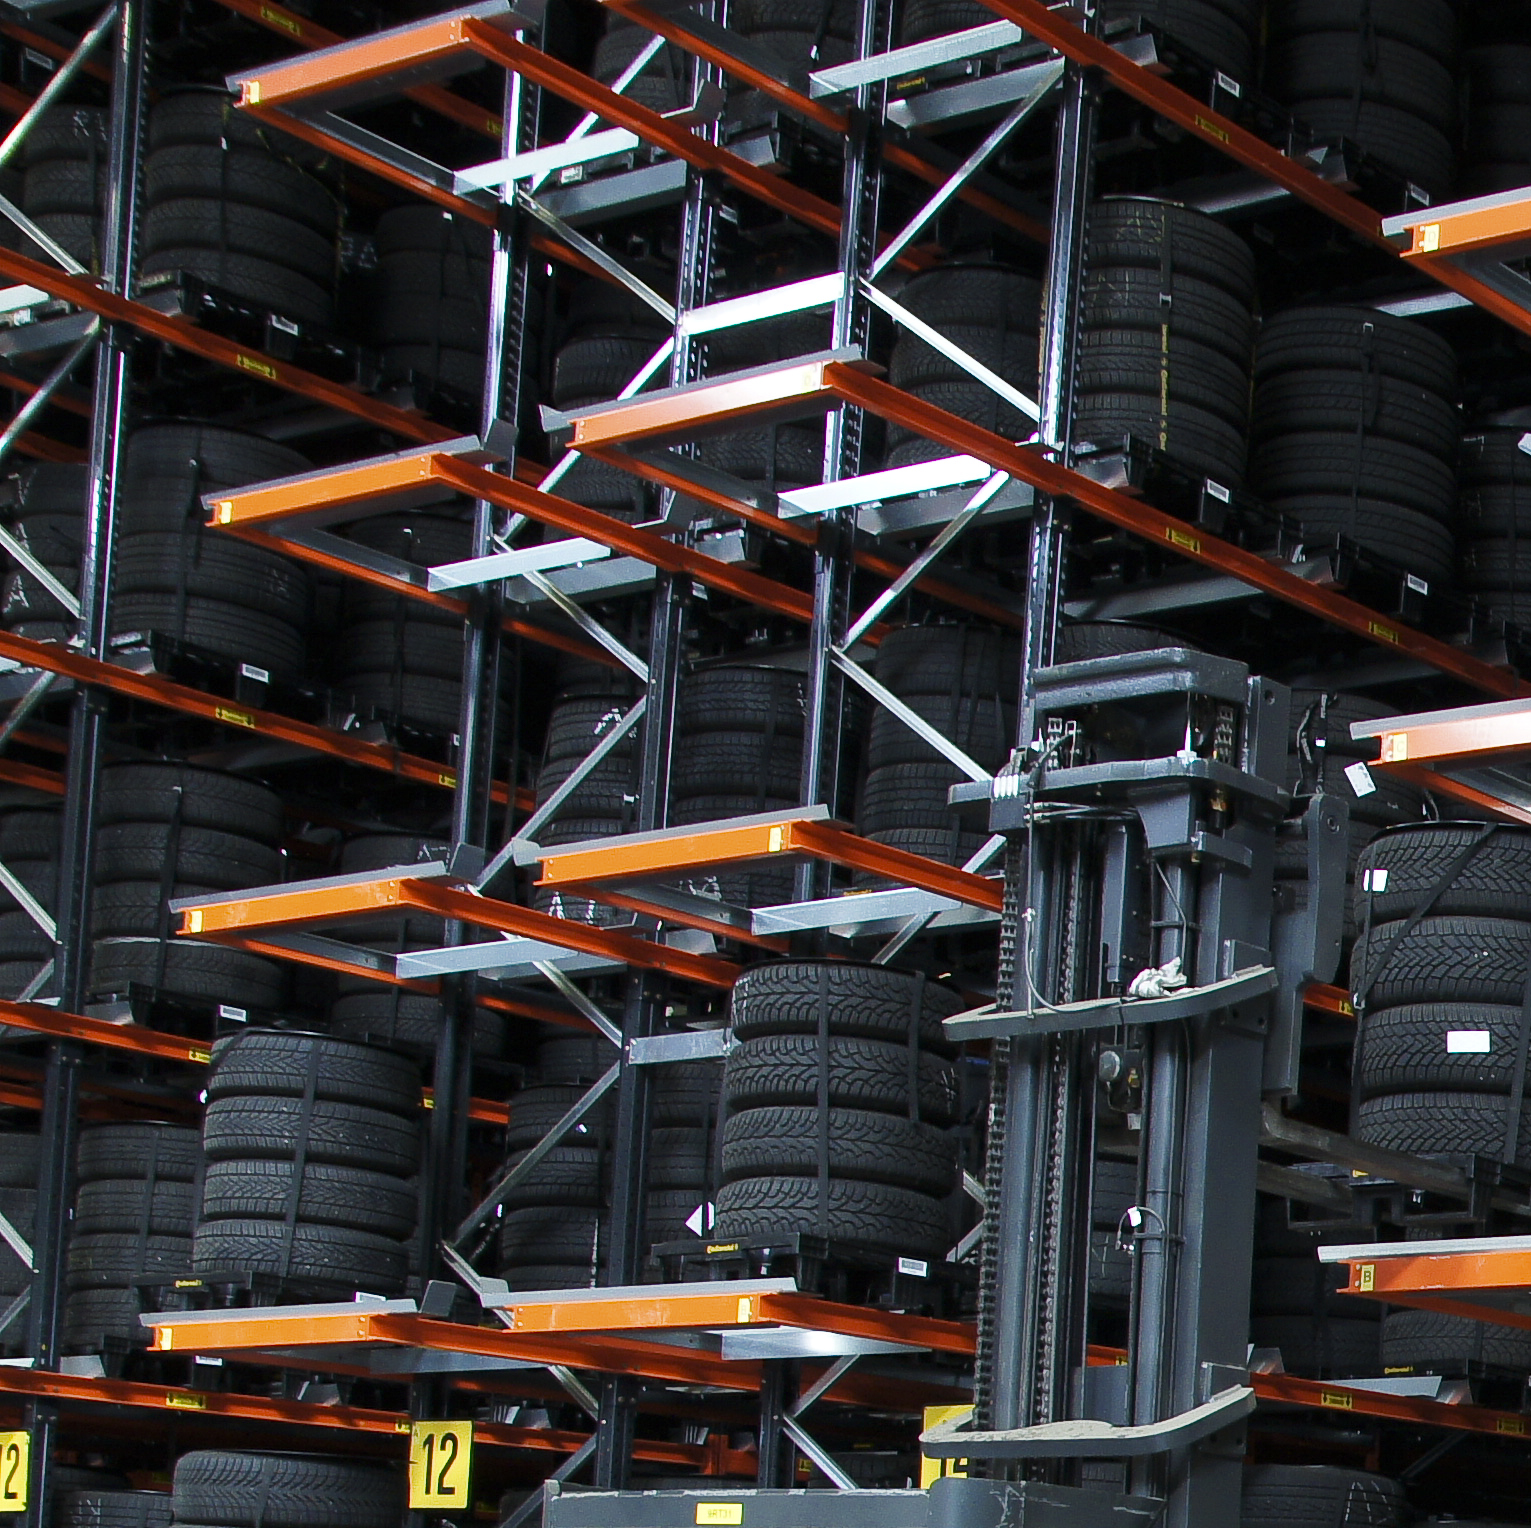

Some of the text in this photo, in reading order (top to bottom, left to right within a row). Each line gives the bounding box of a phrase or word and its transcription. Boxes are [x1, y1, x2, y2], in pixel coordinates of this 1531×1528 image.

[1363, 1272, 1372, 1283] B
[0, 1442, 21, 1500] 2
[422, 1433, 460, 1496] 12
